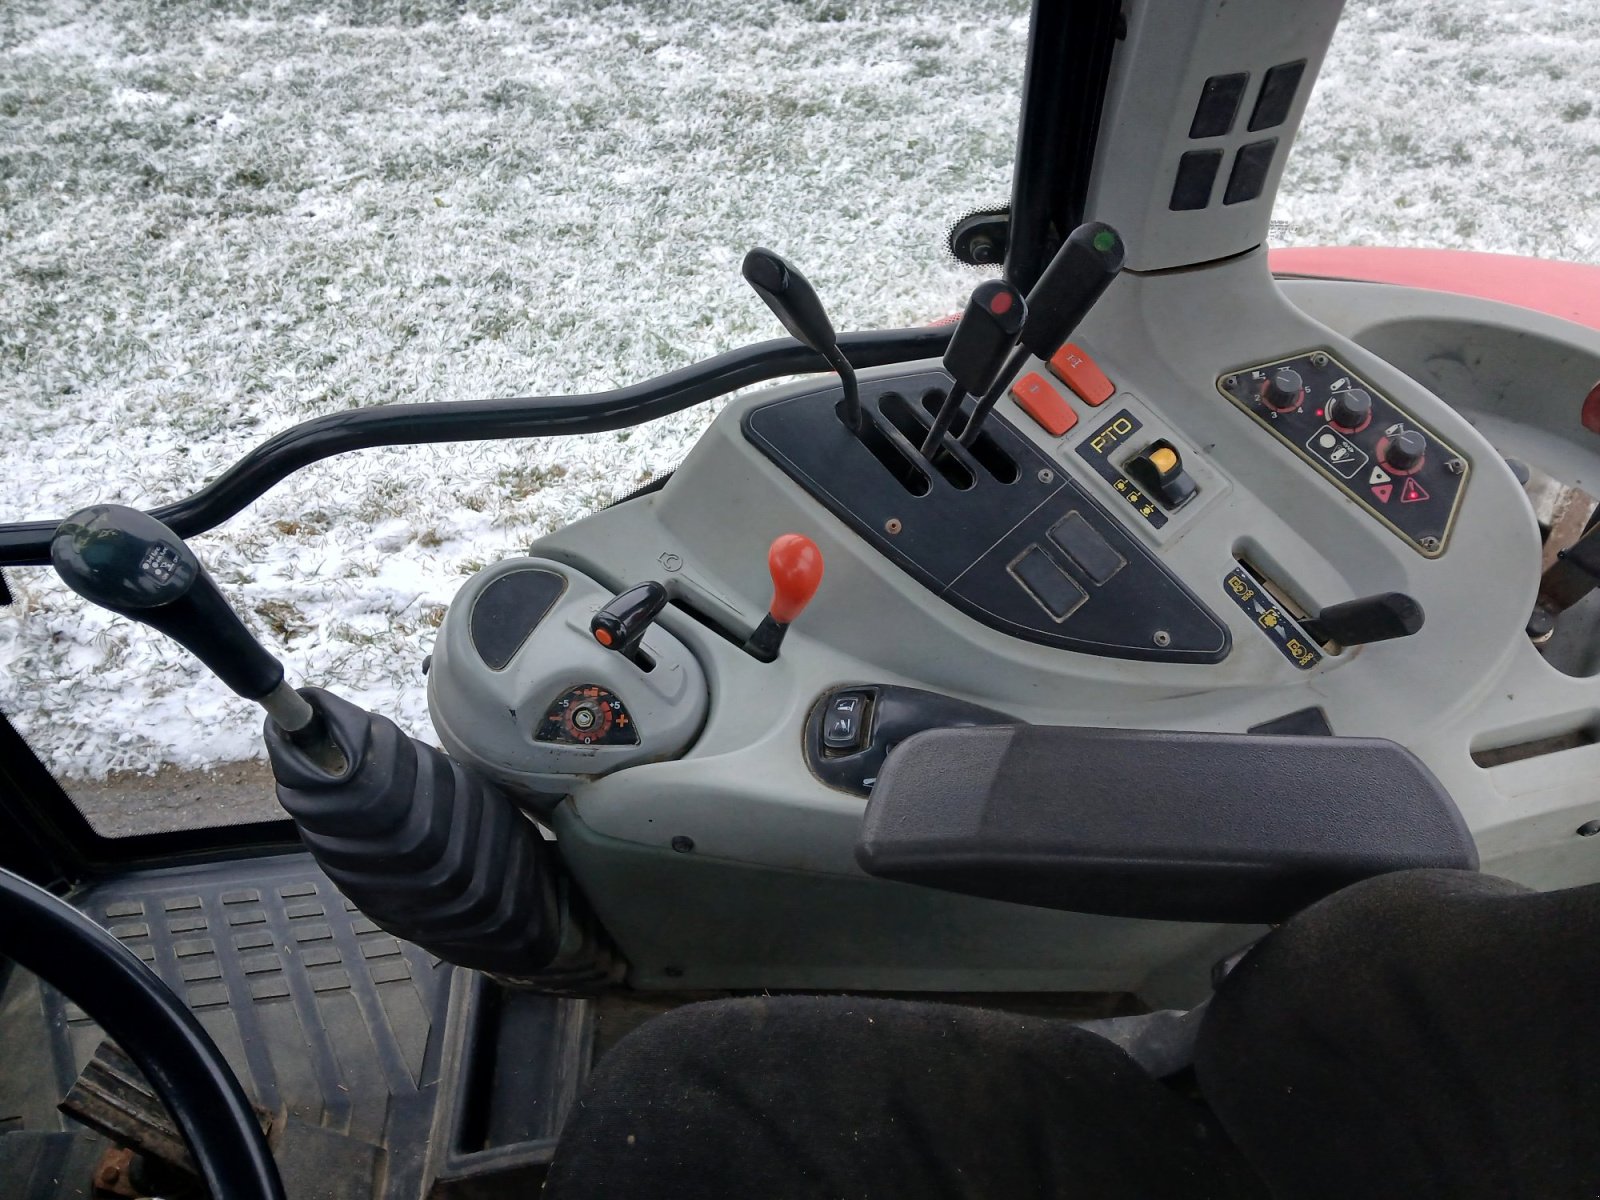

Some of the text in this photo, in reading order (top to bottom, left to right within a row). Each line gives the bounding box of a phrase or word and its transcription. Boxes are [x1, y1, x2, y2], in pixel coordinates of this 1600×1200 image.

[1297, 406, 1304, 414] 4
[1270, 411, 1278, 419] 3
[1090, 417, 1132, 454] PTO
[609, 701, 621, 710] +5
[584, 736, 591, 744] 0
